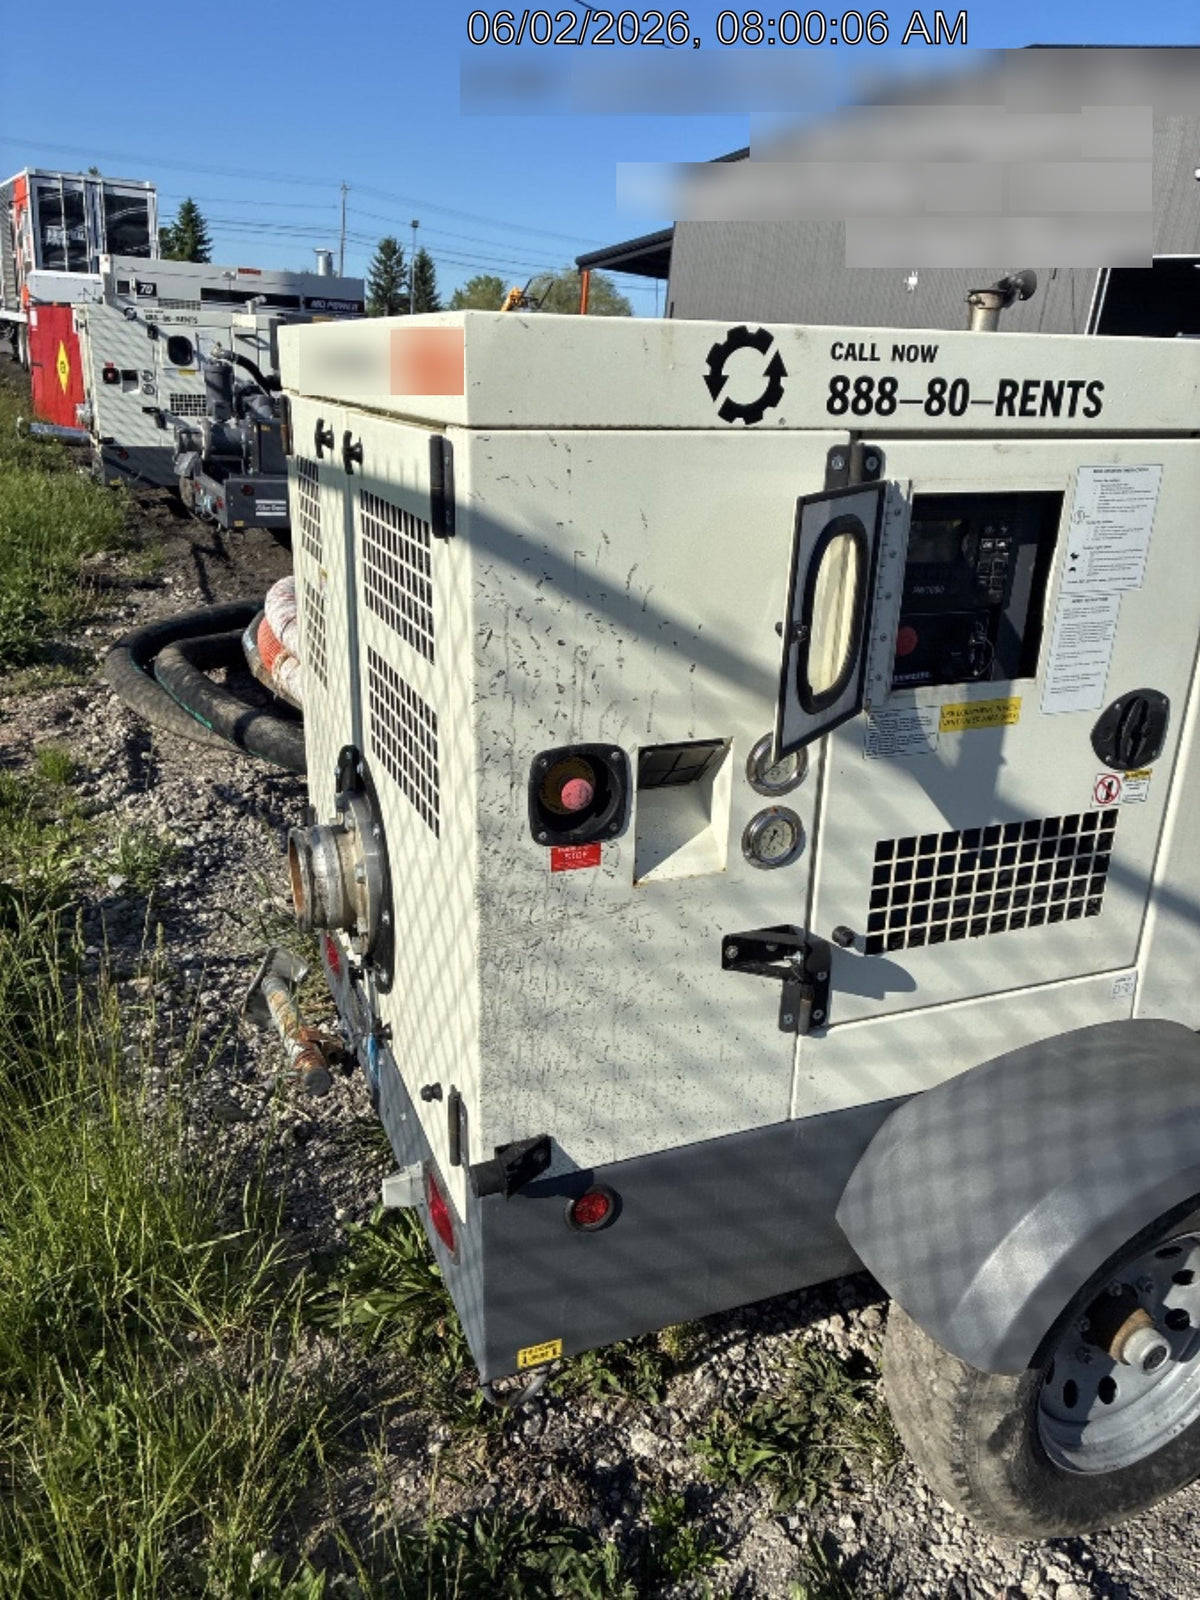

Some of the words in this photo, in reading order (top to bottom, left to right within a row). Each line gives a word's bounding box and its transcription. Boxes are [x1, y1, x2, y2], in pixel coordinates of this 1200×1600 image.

[139, 283, 154, 294] 70
[831, 343, 880, 361] CALL
[892, 345, 938, 362] NOW
[827, 375, 1104, 418] 888-80-RENTS
